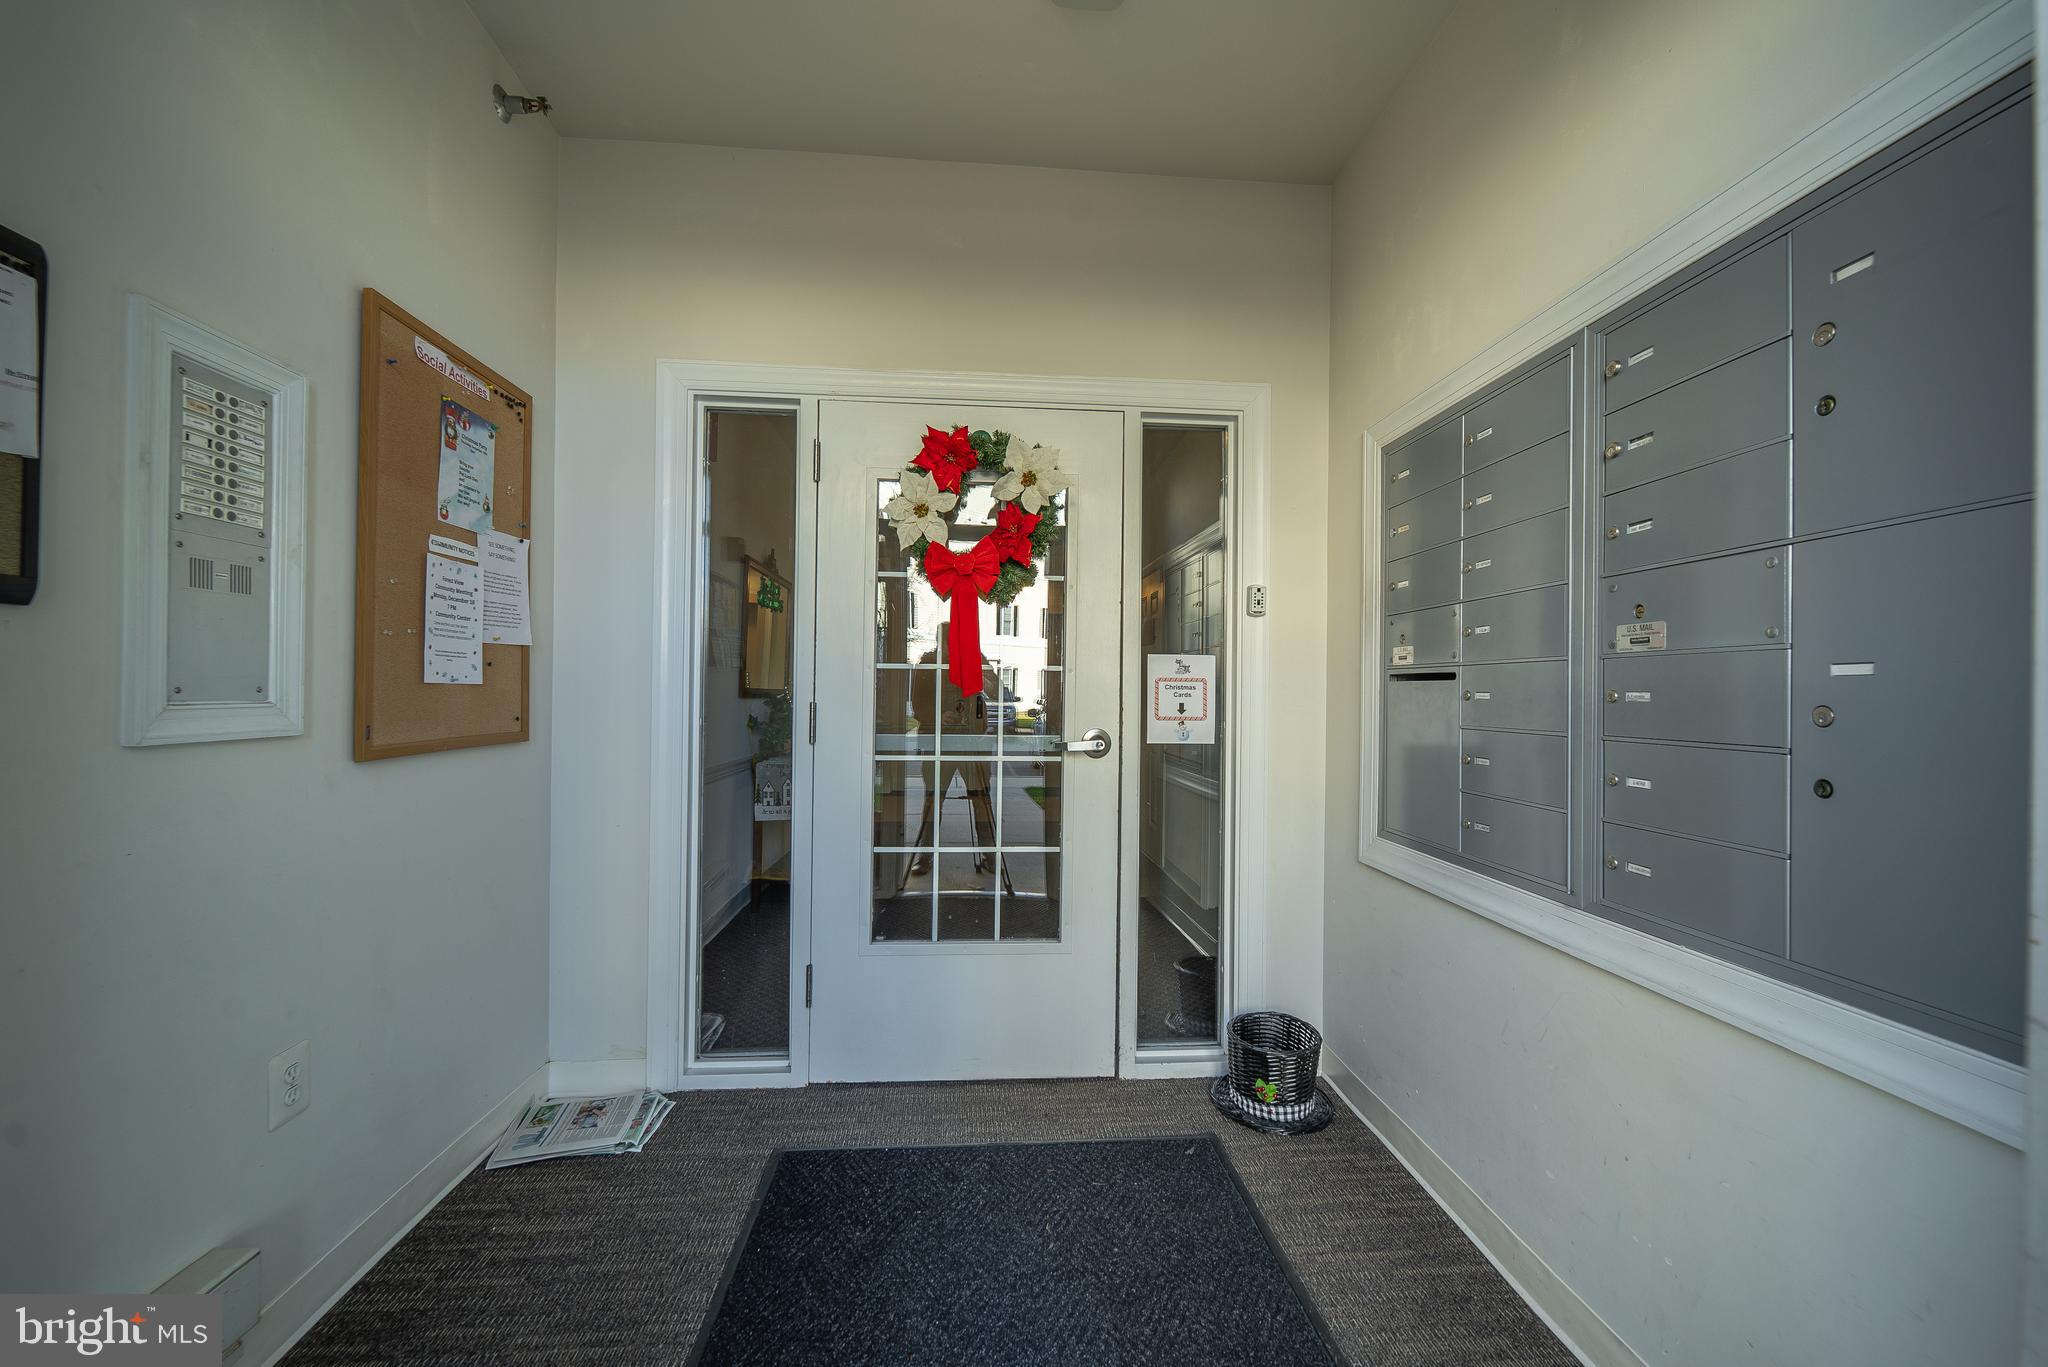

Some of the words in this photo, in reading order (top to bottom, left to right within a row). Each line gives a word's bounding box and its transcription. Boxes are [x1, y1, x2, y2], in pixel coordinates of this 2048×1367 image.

[416, 345, 447, 374] Social
[448, 367, 488, 399] Activities
[431, 539, 459, 552] COMMUNITY
[458, 547, 475, 557] NOTICES
[442, 575, 454, 584] Forest
[456, 588, 474, 597] Meeting
[448, 595, 469, 604] December
[456, 613, 472, 621] Center
[1626, 625, 1638, 633] U.S.
[1639, 623, 1655, 631] MAIL
